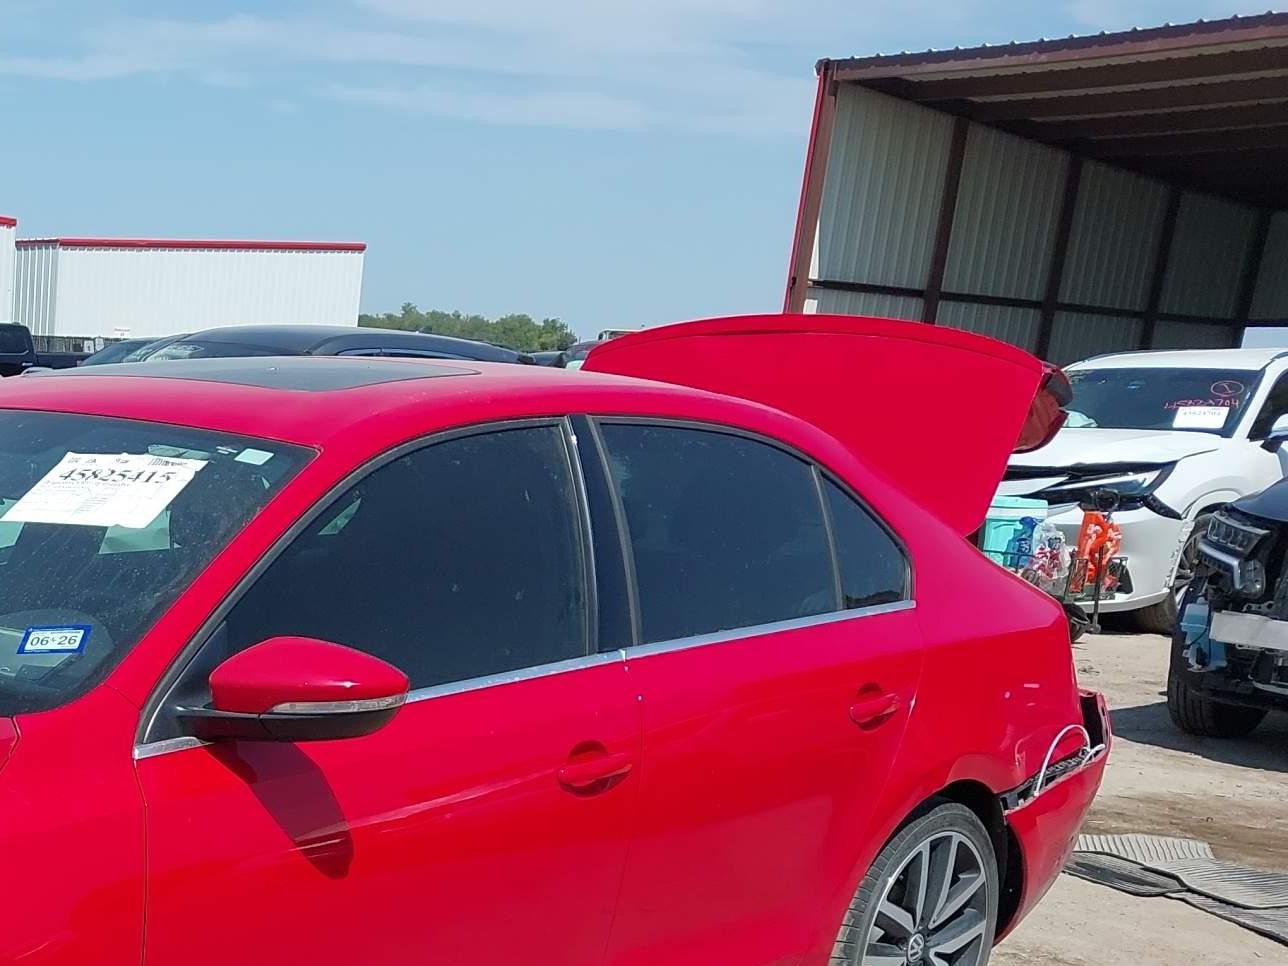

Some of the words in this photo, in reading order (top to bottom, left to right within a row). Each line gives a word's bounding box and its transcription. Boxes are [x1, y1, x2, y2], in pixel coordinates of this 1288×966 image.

[59, 468, 176, 483] 45825415
[30, 636, 50, 646] 06
[57, 635, 78, 646] 26
